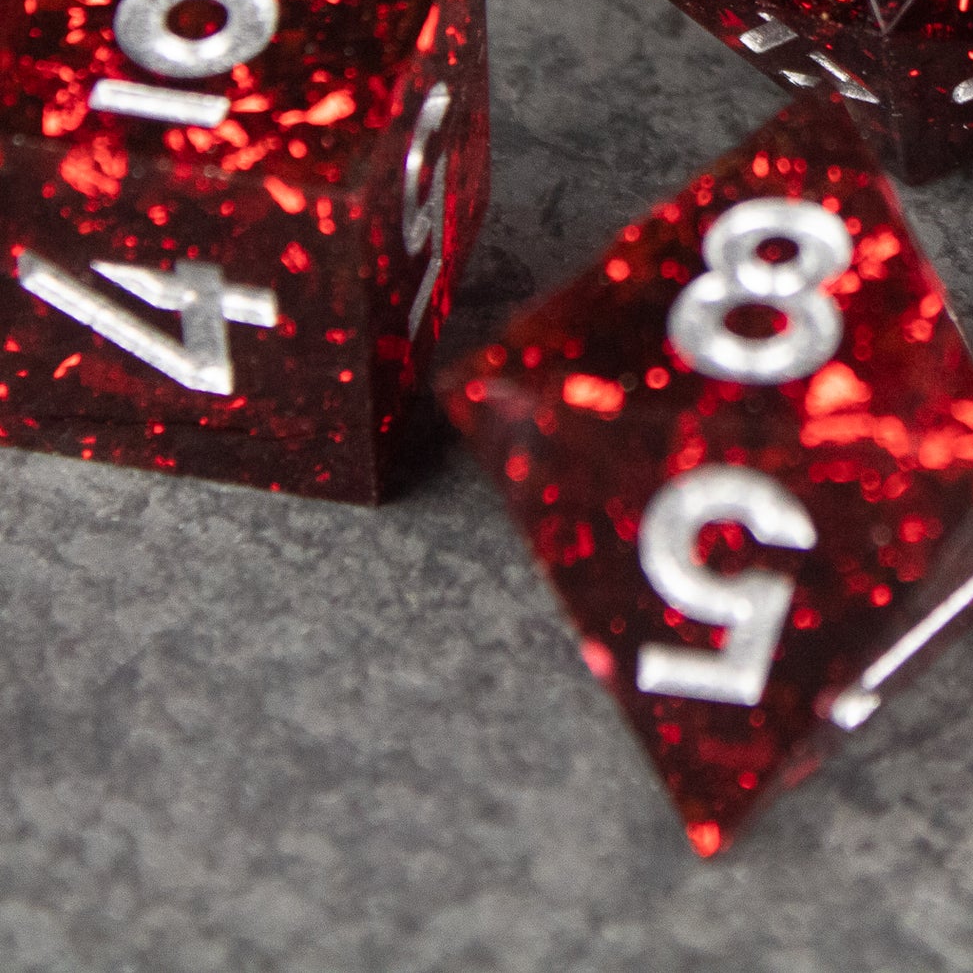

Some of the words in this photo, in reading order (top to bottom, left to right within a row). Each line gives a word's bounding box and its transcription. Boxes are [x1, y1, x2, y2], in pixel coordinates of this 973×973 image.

[16, 248, 278, 396] 4
[667, 197, 855, 385] 8
[637, 463, 817, 706] 5
